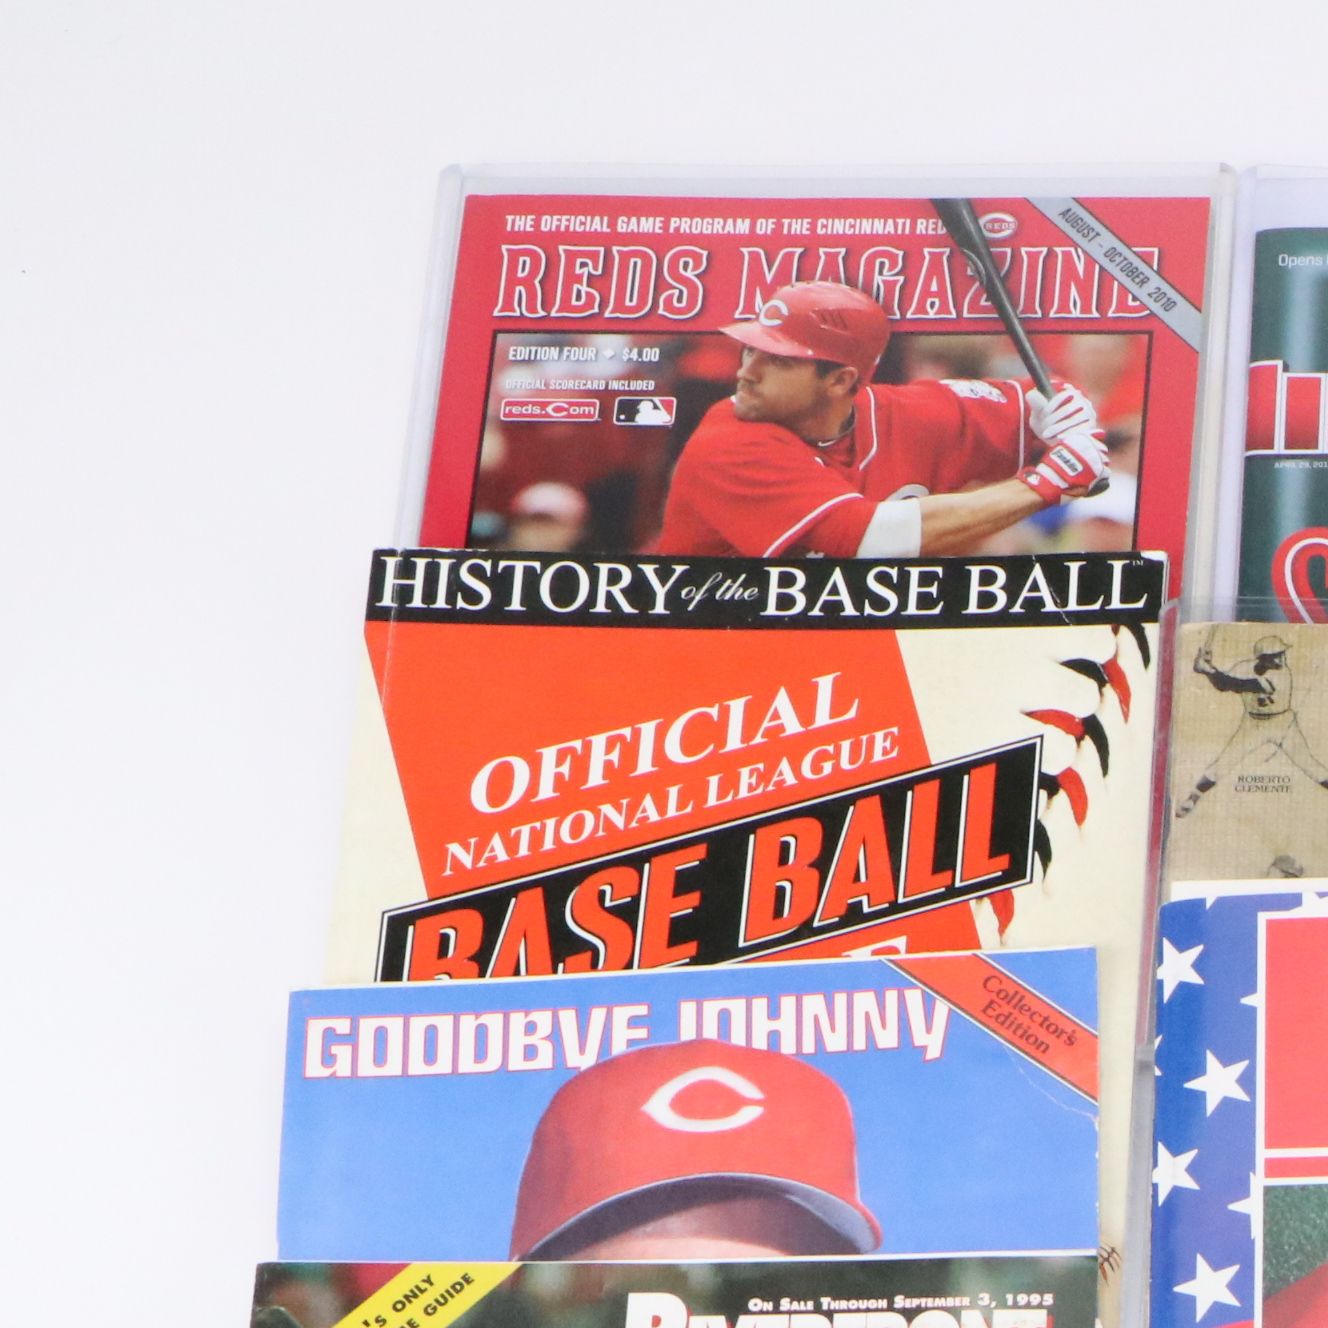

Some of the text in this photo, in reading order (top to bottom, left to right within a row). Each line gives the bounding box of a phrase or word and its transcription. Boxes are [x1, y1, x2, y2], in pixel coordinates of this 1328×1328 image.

[506, 214, 911, 236] THE OFFICIAL GAME PROGRAM OF THE CINCINNATI
[493, 244, 709, 319] REDS
[1278, 254, 1325, 268] Opens
[508, 346, 661, 363] EDITION FOUR $4.00
[549, 379, 656, 391] SCORECARD INCLUDED
[380, 555, 1150, 618] HISTORY BASE BALL
[469, 672, 860, 815] OFFICIAL
[442, 726, 903, 877] NATIONAL LEAGUE
[406, 759, 1012, 985] BASE BALL
[391, 1273, 435, 1314] ONLY
[422, 1271, 476, 1317] GUIDE
[820, 1292, 1054, 1311] THROUGH SEPTEMBER 1995
